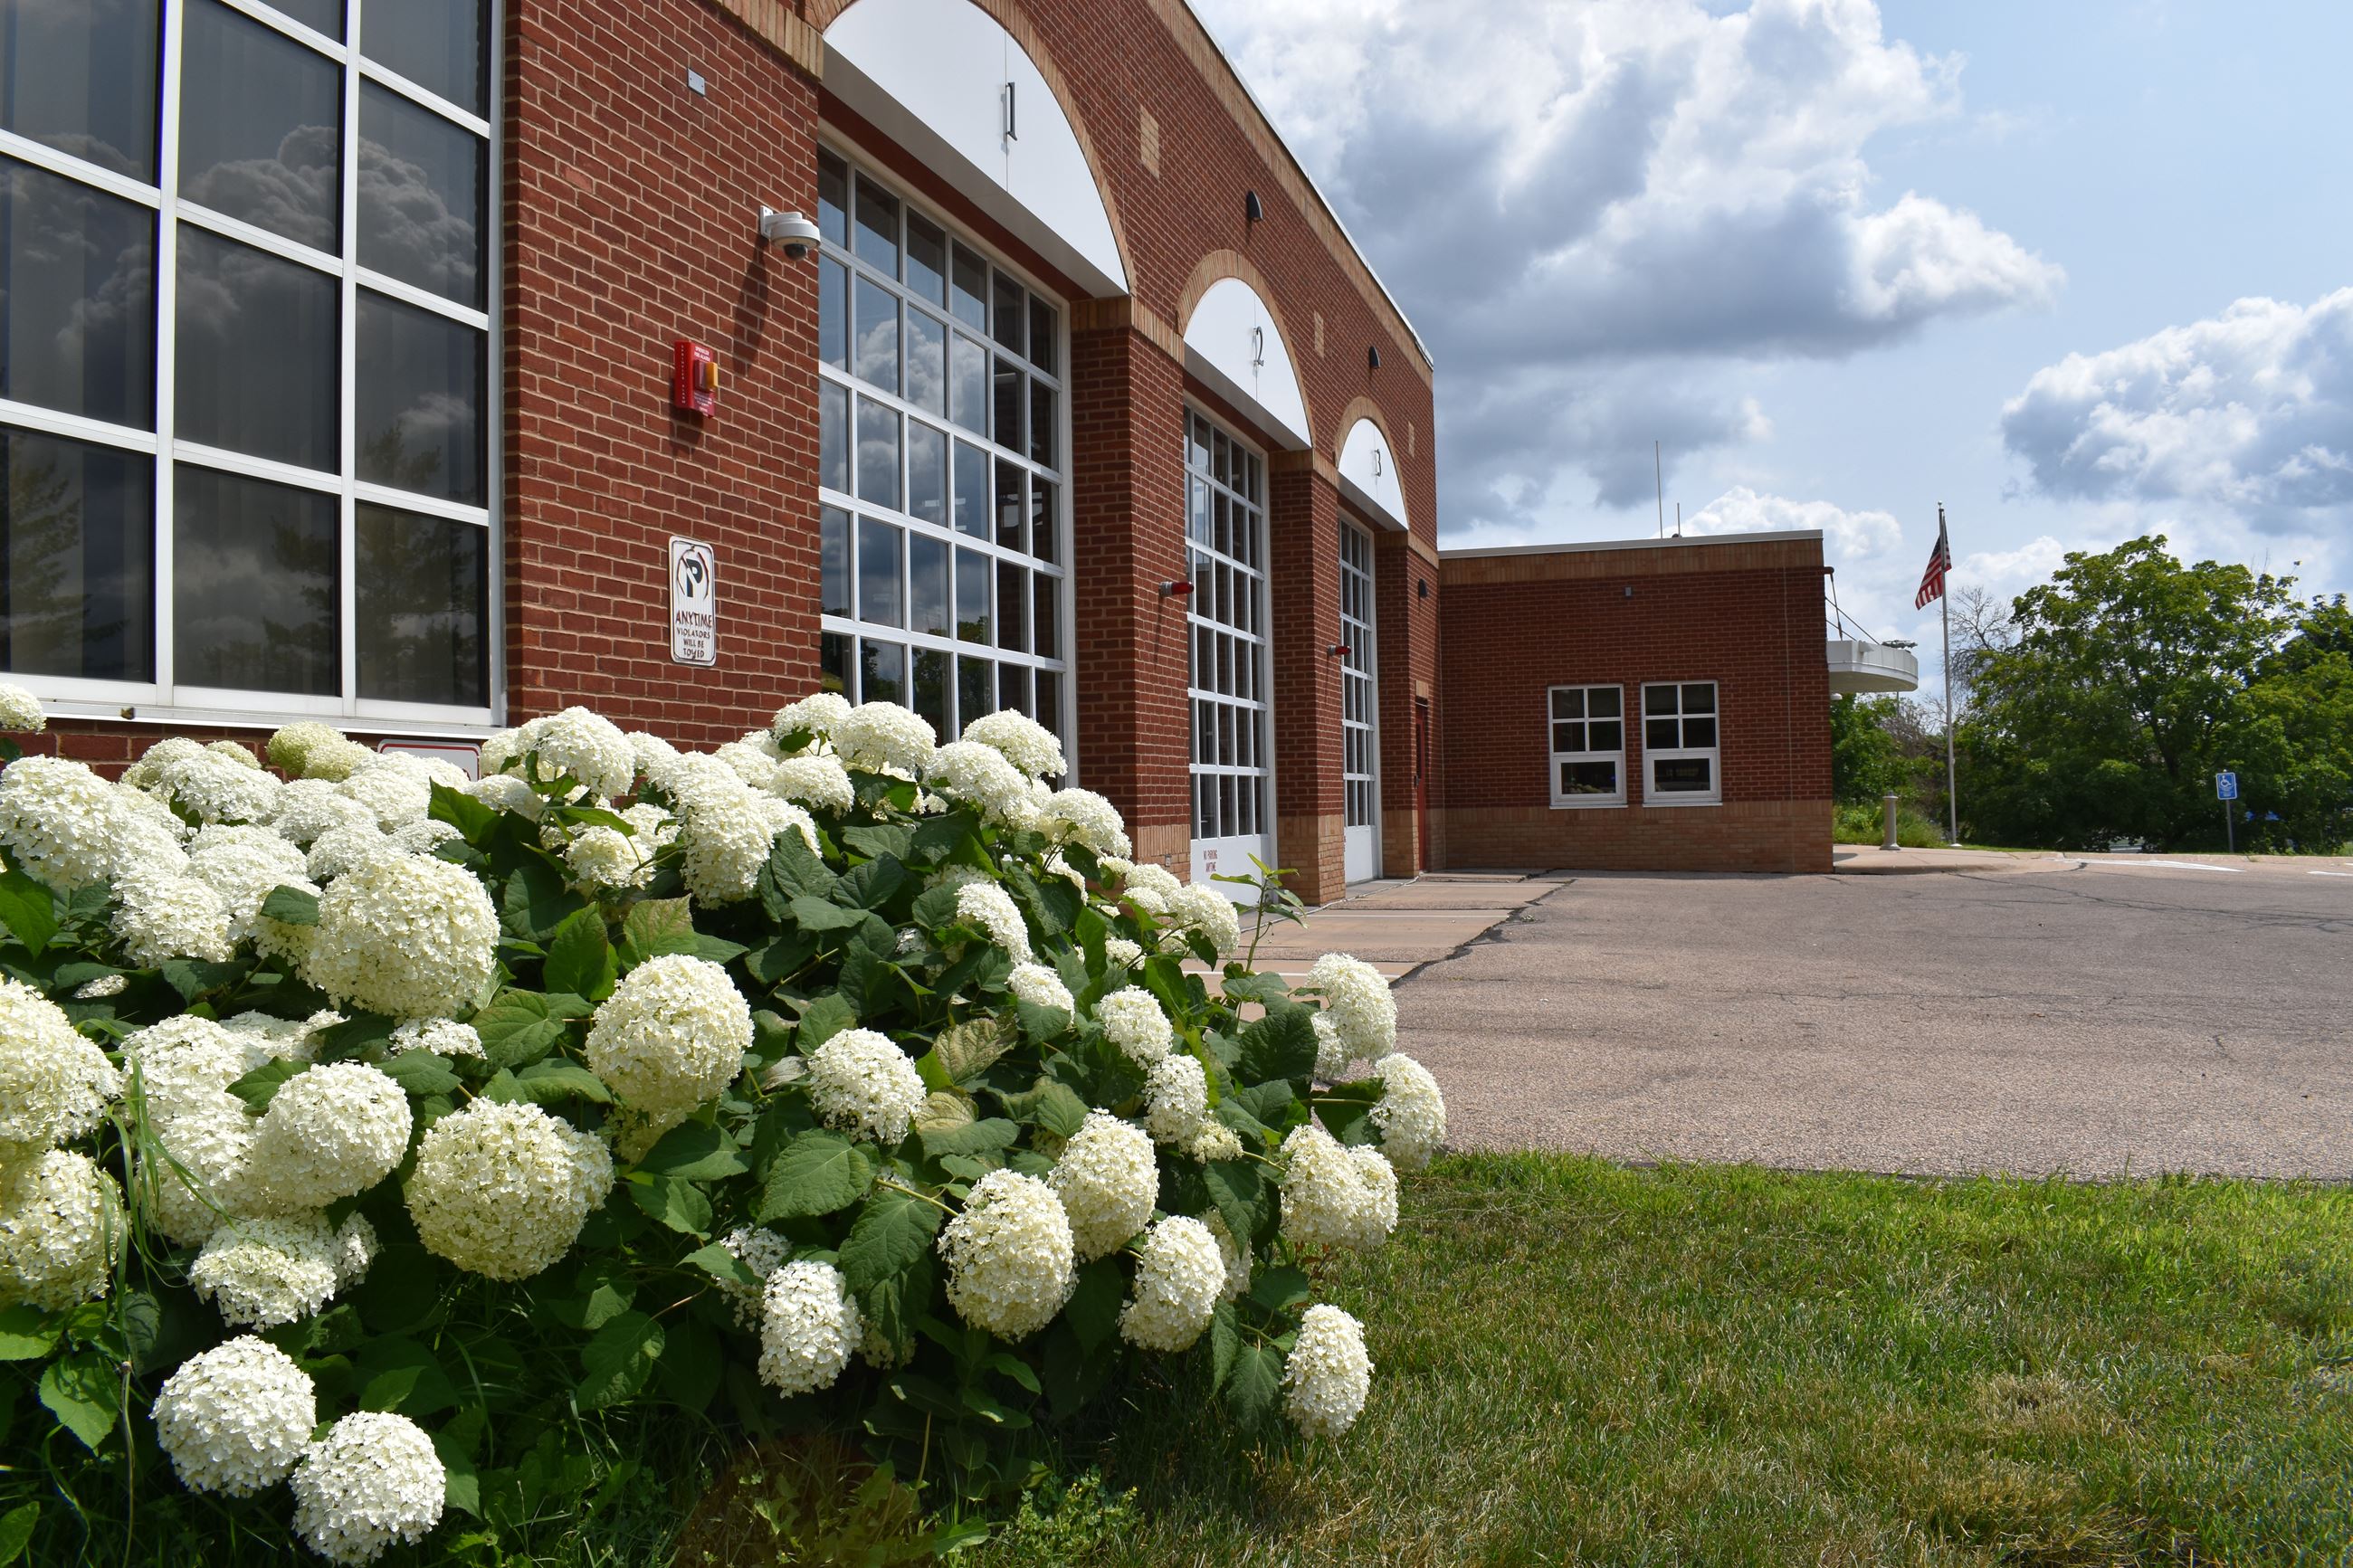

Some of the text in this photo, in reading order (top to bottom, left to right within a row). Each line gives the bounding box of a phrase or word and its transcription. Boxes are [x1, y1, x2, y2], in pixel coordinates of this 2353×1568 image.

[675, 610, 712, 628] ANYTIME
[676, 626, 710, 639] VIOLATORS
[683, 638, 704, 649] WILL BE
